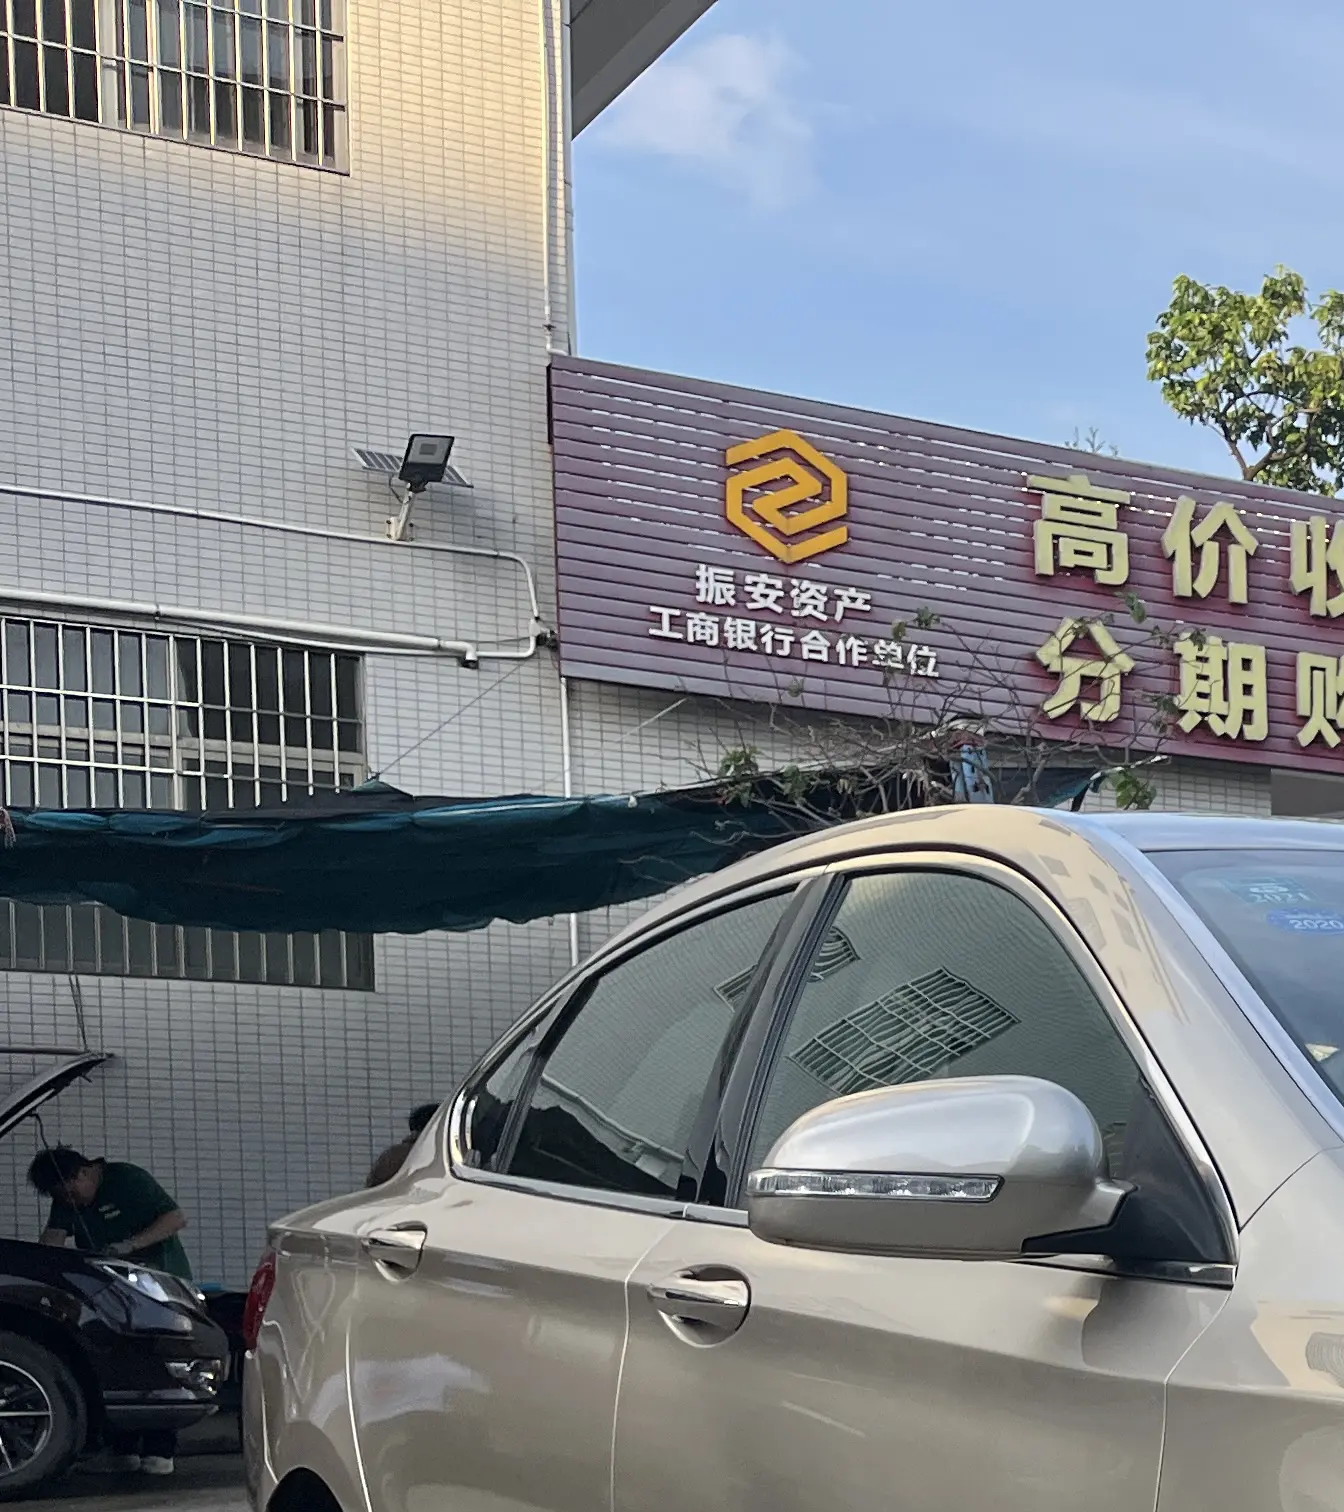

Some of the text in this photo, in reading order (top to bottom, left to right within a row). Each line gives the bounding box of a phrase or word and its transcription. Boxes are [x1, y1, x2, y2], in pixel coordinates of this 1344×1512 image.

[695, 563, 872, 623] 振安资产
[648, 605, 940, 678] 工商银行合作单位
[1288, 918, 1344, 930] 2020
